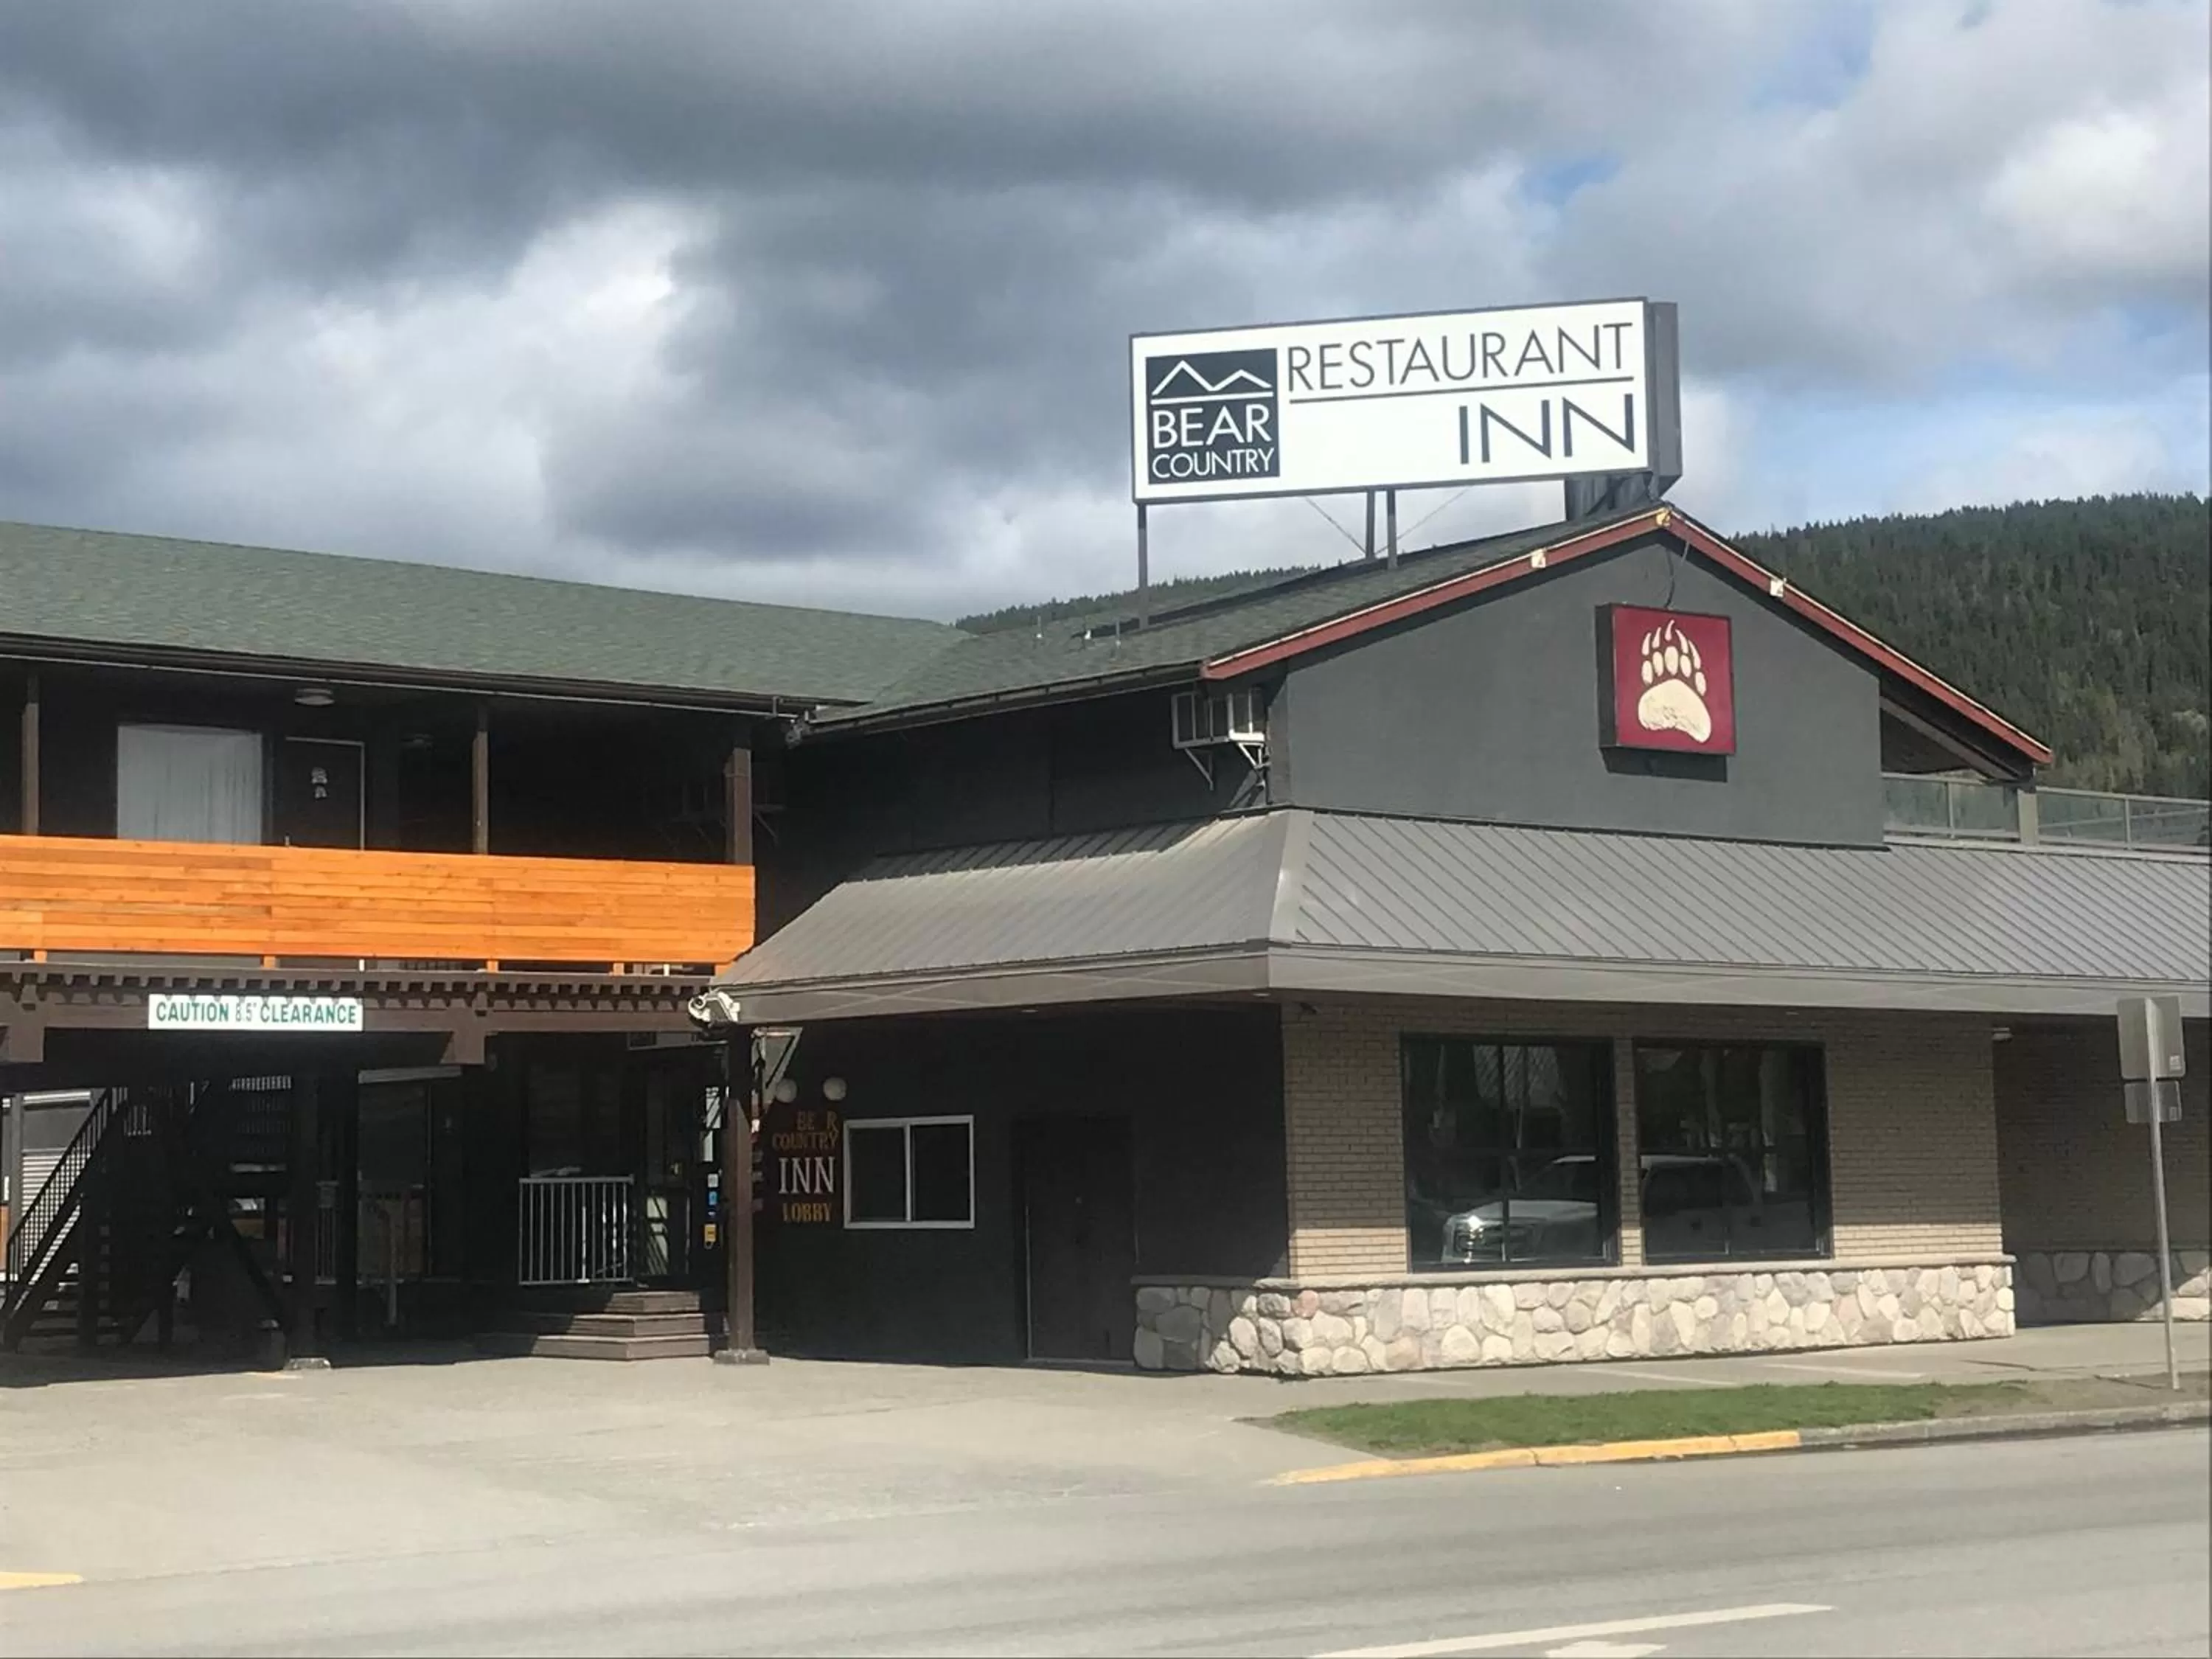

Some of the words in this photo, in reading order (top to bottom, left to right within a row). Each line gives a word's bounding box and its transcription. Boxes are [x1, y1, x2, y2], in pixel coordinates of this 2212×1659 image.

[1287, 321, 1633, 392] RESTAURANT
[1152, 403, 1273, 449] BEAR
[1459, 393, 1635, 465] INN
[1151, 448, 1276, 479] COUNTRY
[156, 1001, 229, 1022] CAUTION
[260, 1003, 357, 1024] CLEARANCE
[772, 1133, 839, 1150] COUNTRY
[778, 1156, 835, 1194] INN
